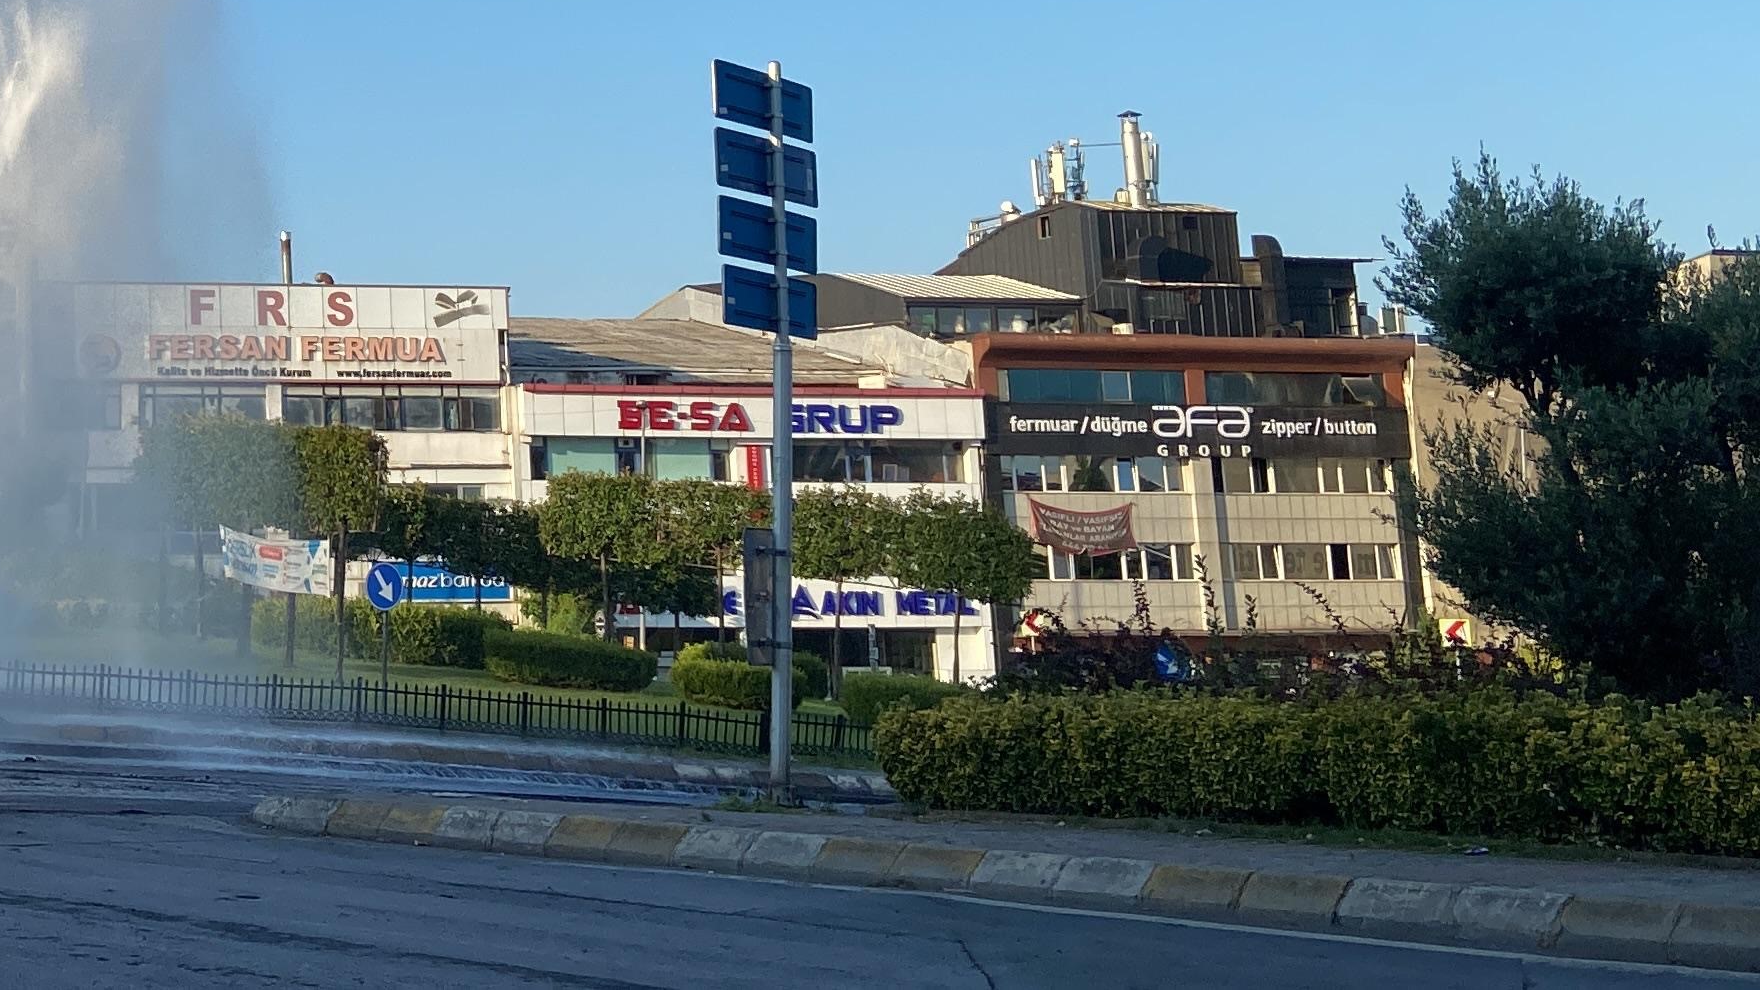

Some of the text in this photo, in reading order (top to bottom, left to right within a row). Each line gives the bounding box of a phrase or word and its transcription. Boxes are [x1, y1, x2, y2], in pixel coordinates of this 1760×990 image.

[149, 335, 289, 361] FERSAN
[157, 366, 187, 376] Kalite
[191, 368, 202, 376] ve
[204, 366, 248, 377] Hizmette
[280, 367, 312, 377] Kurum
[1157, 444, 1252, 457] GROUP
